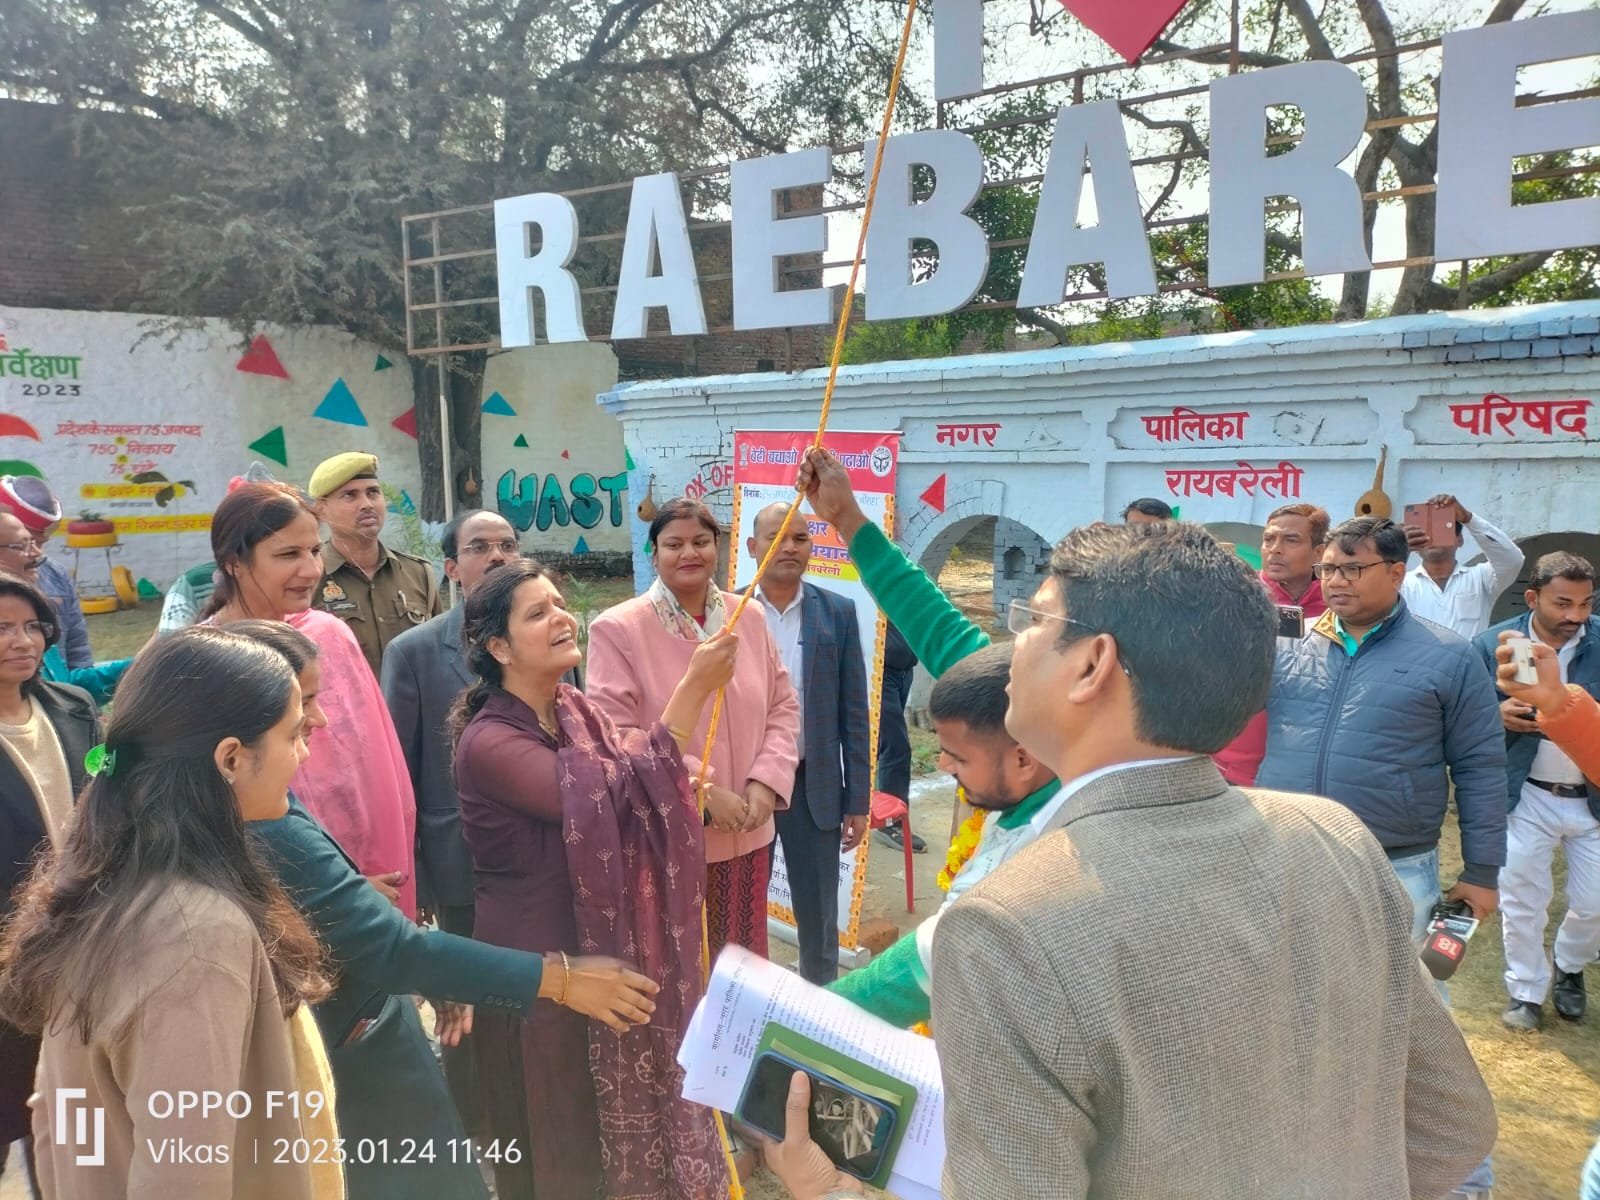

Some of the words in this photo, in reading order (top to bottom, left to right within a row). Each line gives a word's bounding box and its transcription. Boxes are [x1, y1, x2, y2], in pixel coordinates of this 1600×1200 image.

[0, 347, 82, 380] र्वेक्षण
[22, 383, 81, 397] 2023
[936, 422, 1002, 447] नगर
[1141, 406, 1250, 443] पालिका
[1449, 393, 1593, 437] परिषद
[88, 443, 118, 455] 750
[1165, 460, 1304, 499] रायबरेली
[497, 468, 628, 532] WAST
